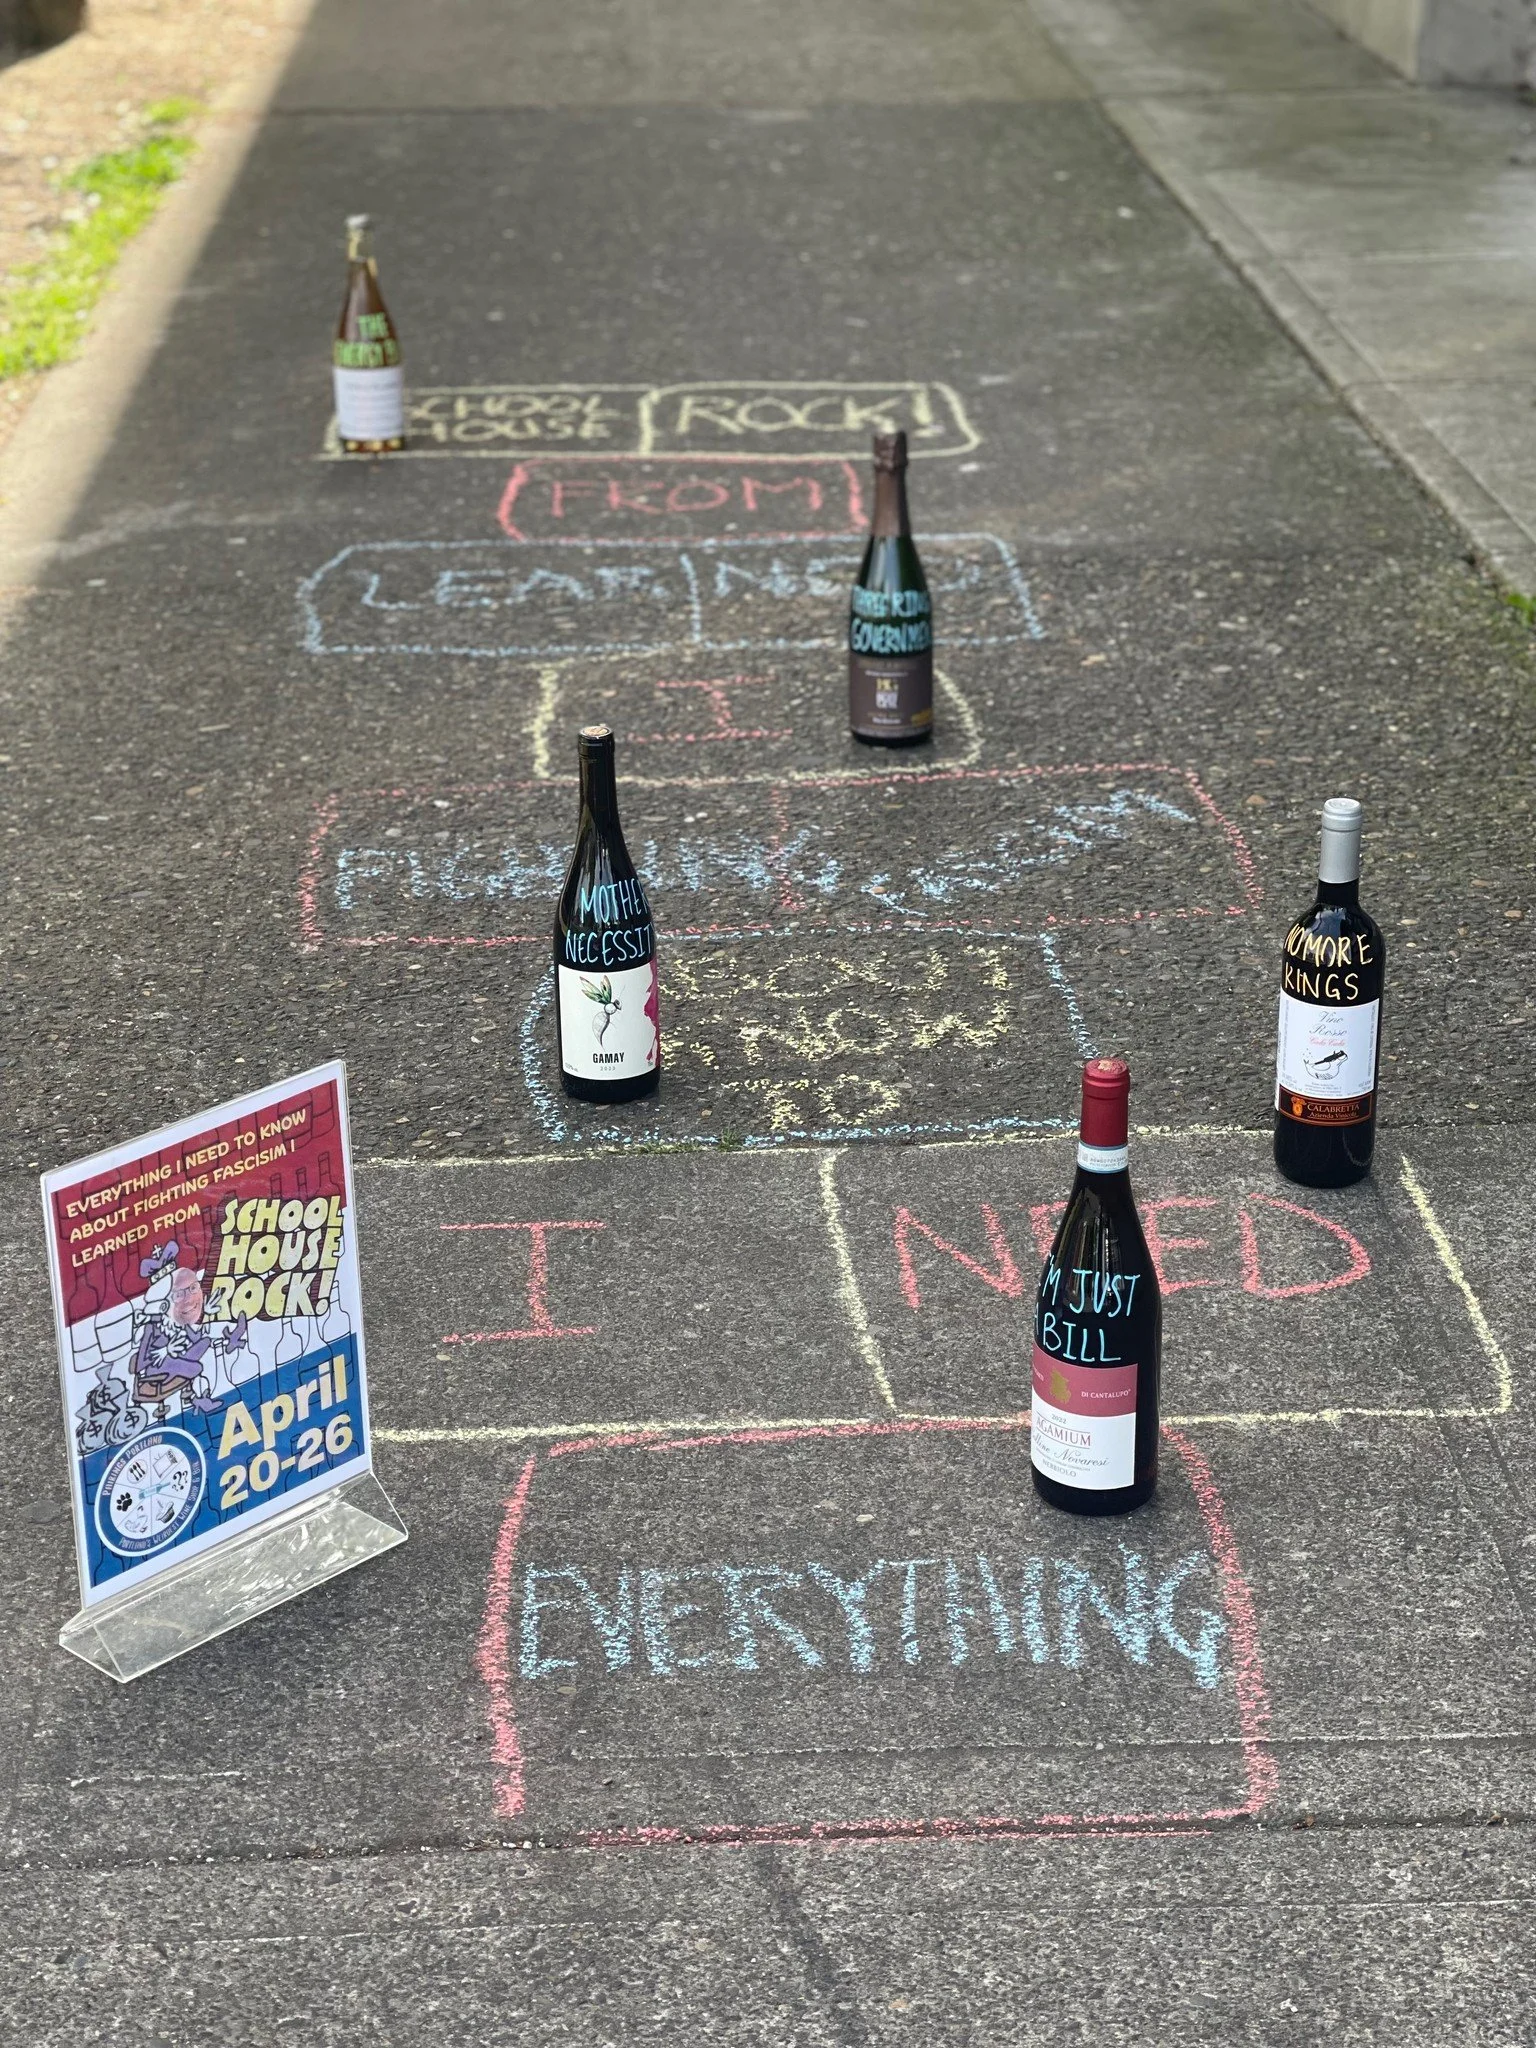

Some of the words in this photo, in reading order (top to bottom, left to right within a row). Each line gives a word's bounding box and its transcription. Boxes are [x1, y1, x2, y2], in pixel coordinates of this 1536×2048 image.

[676, 391, 940, 437] ROCK!
[552, 475, 822, 518] FROM
[628, 676, 793, 742] I
[336, 824, 844, 910] FIGHING
[1285, 962, 1359, 1000] KINGS
[1309, 1023, 1347, 1036] Rosso
[593, 1052, 625, 1063] GAMAY
[722, 1073, 902, 1131] TO
[1307, 1104, 1360, 1113] CALABRETTA
[66, 1163, 171, 1218] EVERYTHING
[176, 1159, 181, 1173] I
[185, 1141, 230, 1170] NEED
[233, 1131, 256, 1150] TO
[260, 1109, 307, 1139] KNOW
[69, 1210, 128, 1243] ABOUT
[133, 1176, 209, 1217] FIGHTING
[213, 1143, 287, 1183] FASCISIM
[220, 1195, 343, 1234] SCHOOL
[71, 1225, 149, 1268] LEARNED
[153, 1202, 201, 1234] FROM
[216, 1226, 342, 1276] HOUSE
[209, 1268, 338, 1321] ROCK!
[440, 1220, 606, 1343] I
[1069, 1269, 1140, 1318] JUST
[1043, 1312, 1121, 1362] BILL
[217, 1354, 348, 1461] April
[125, 1435, 163, 1459] PORTLAND
[218, 1414, 353, 1510] 20-26
[178, 1505, 191, 1520] WINE
[524, 1543, 1226, 1690] EVERYTHING
